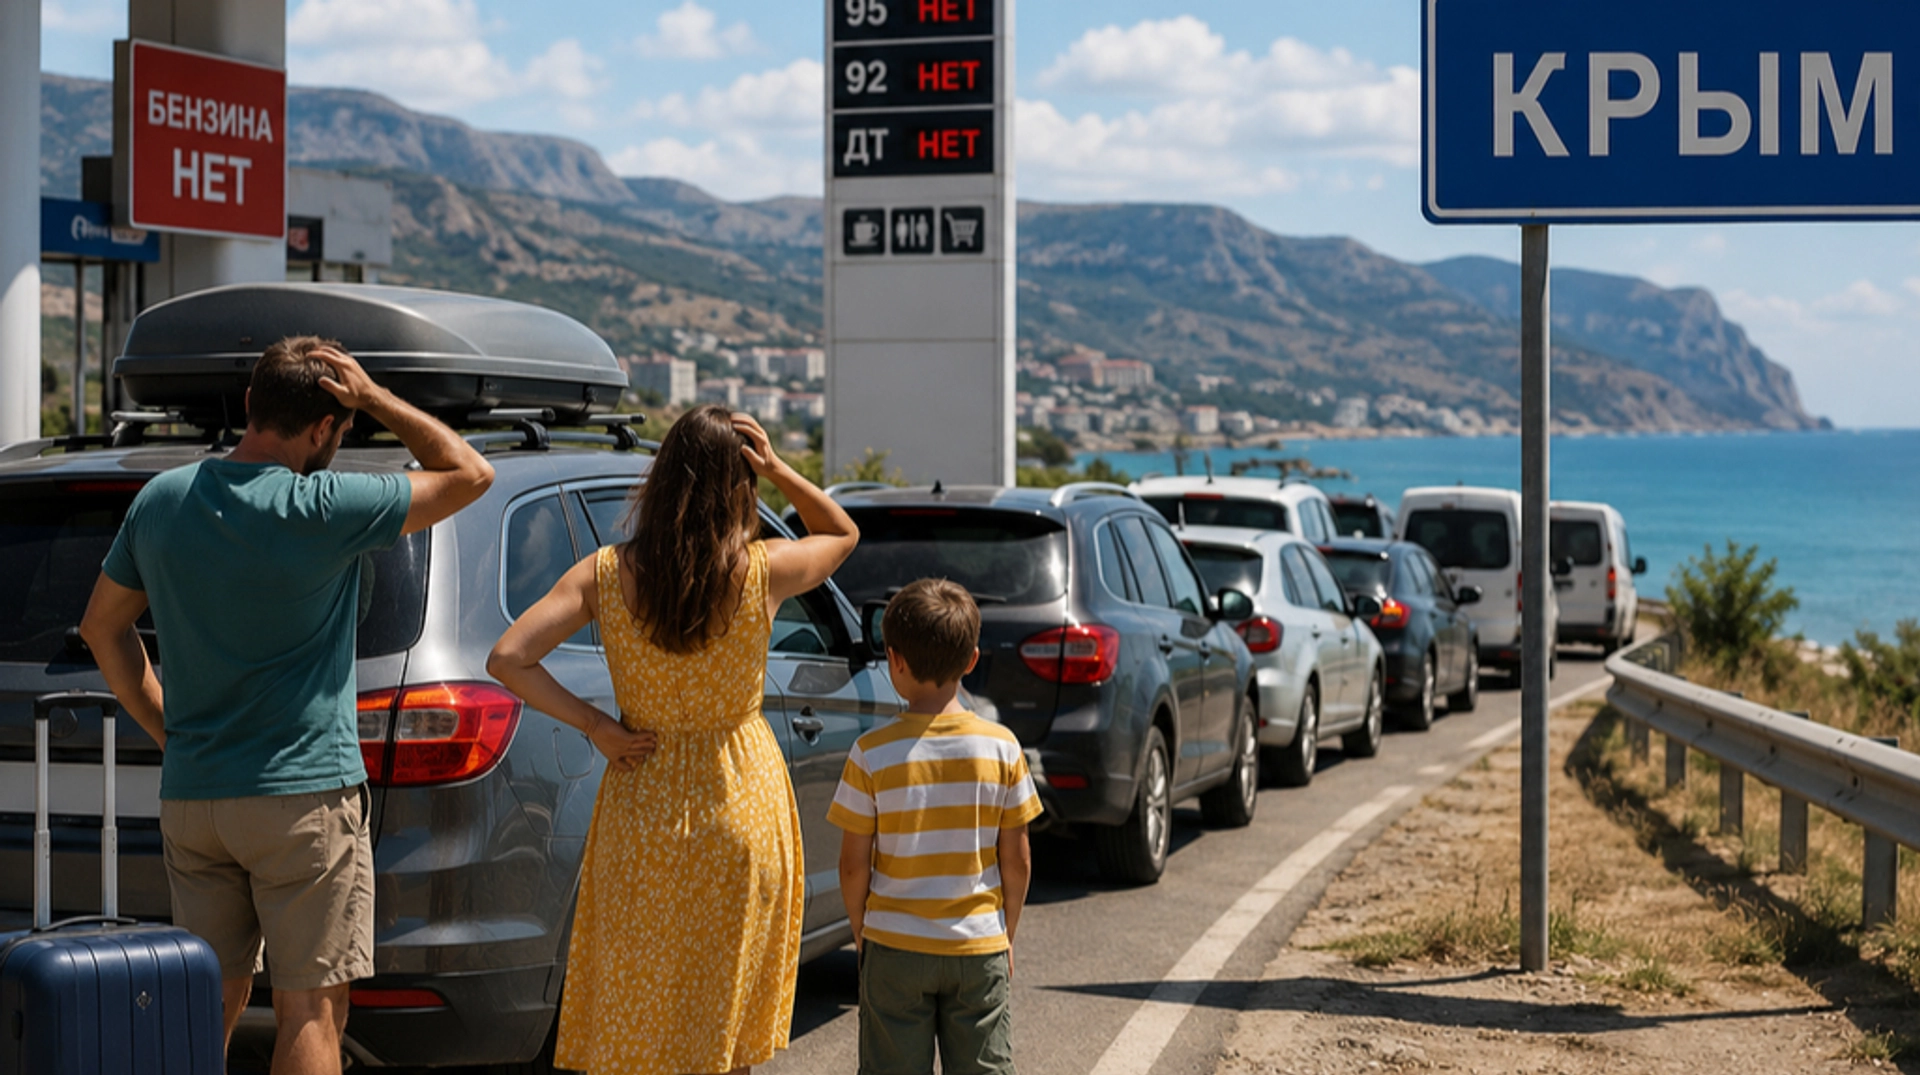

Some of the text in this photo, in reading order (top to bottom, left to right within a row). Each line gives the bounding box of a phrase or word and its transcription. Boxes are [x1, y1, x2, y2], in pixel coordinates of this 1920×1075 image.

[845, 0, 887, 26] 95
[845, 60, 980, 94] 92 НЕТ
[148, 90, 273, 142] БЕНЗИНА
[1493, 51, 1894, 157] КРЫМ
[843, 128, 980, 166] ДТ НЕТ
[173, 148, 252, 205] НЕТ
